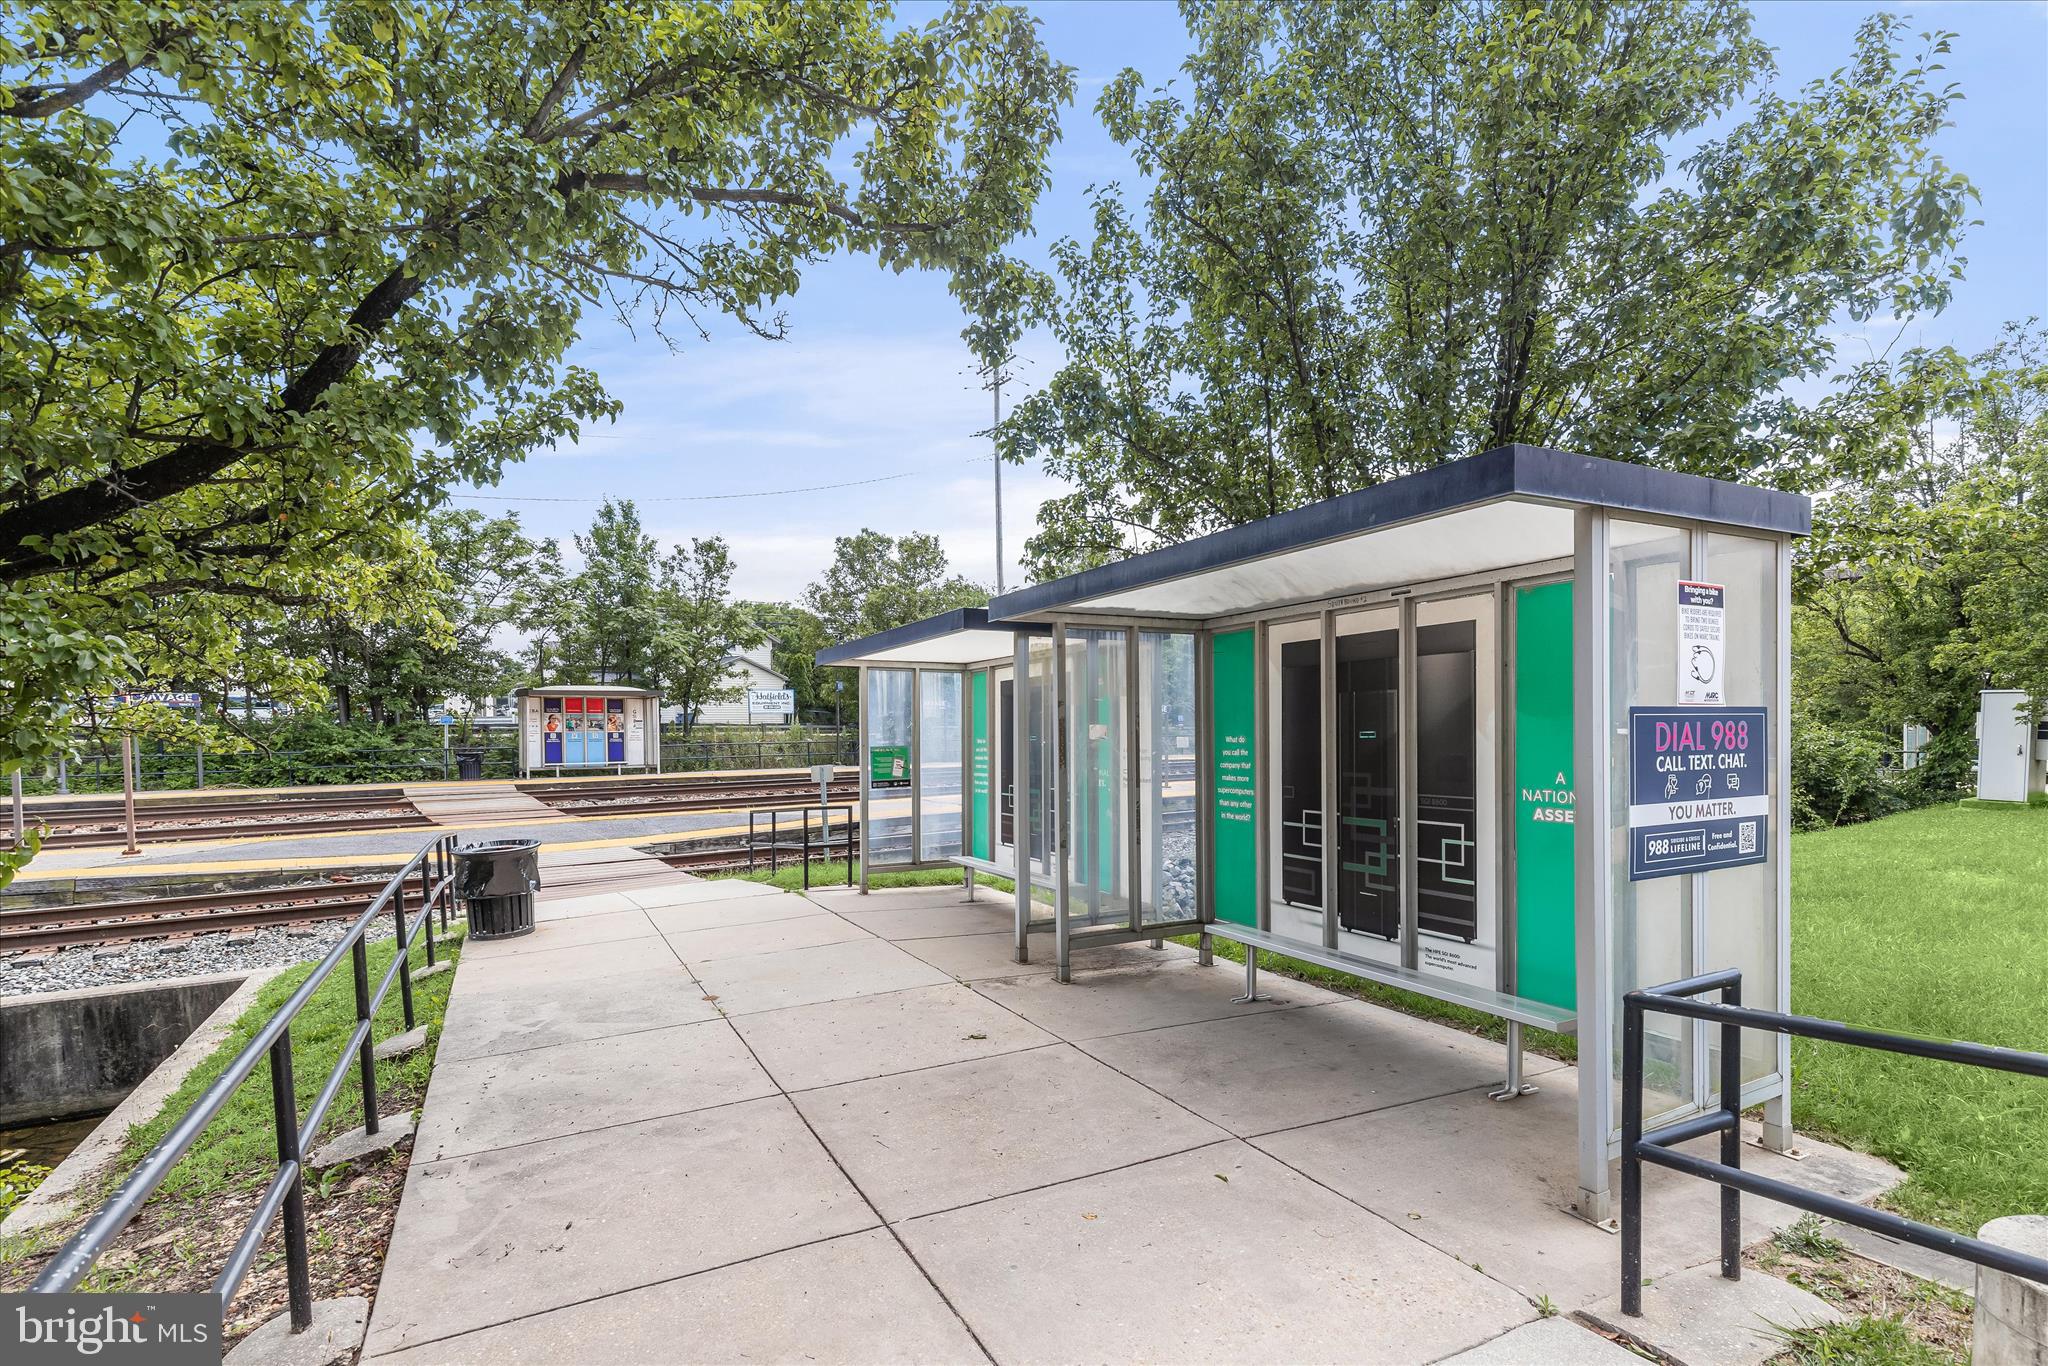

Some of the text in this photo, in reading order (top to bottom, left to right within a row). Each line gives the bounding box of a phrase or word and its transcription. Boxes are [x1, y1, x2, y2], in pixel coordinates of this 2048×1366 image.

[1684, 586, 1705, 596] Bringing
[1709, 588, 1719, 596] bike
[1690, 596, 1714, 606] with you?
[1655, 720, 1749, 752] DIAL 988
[1656, 753, 1748, 772] CALL. TEXT. CHAT.
[1555, 771, 1566, 785] A
[1217, 788, 1254, 796] supercomputers
[1239, 801, 1252, 809] other
[1533, 808, 1576, 823] ASSE
[1668, 801, 1737, 820] YOU MATTER.
[1234, 813, 1251, 821] world?
[1712, 830, 1732, 840] Free and
[1648, 838, 1669, 856] 988
[1670, 843, 1701, 853] LIFELINE
[1707, 841, 1738, 851] Confidential.
